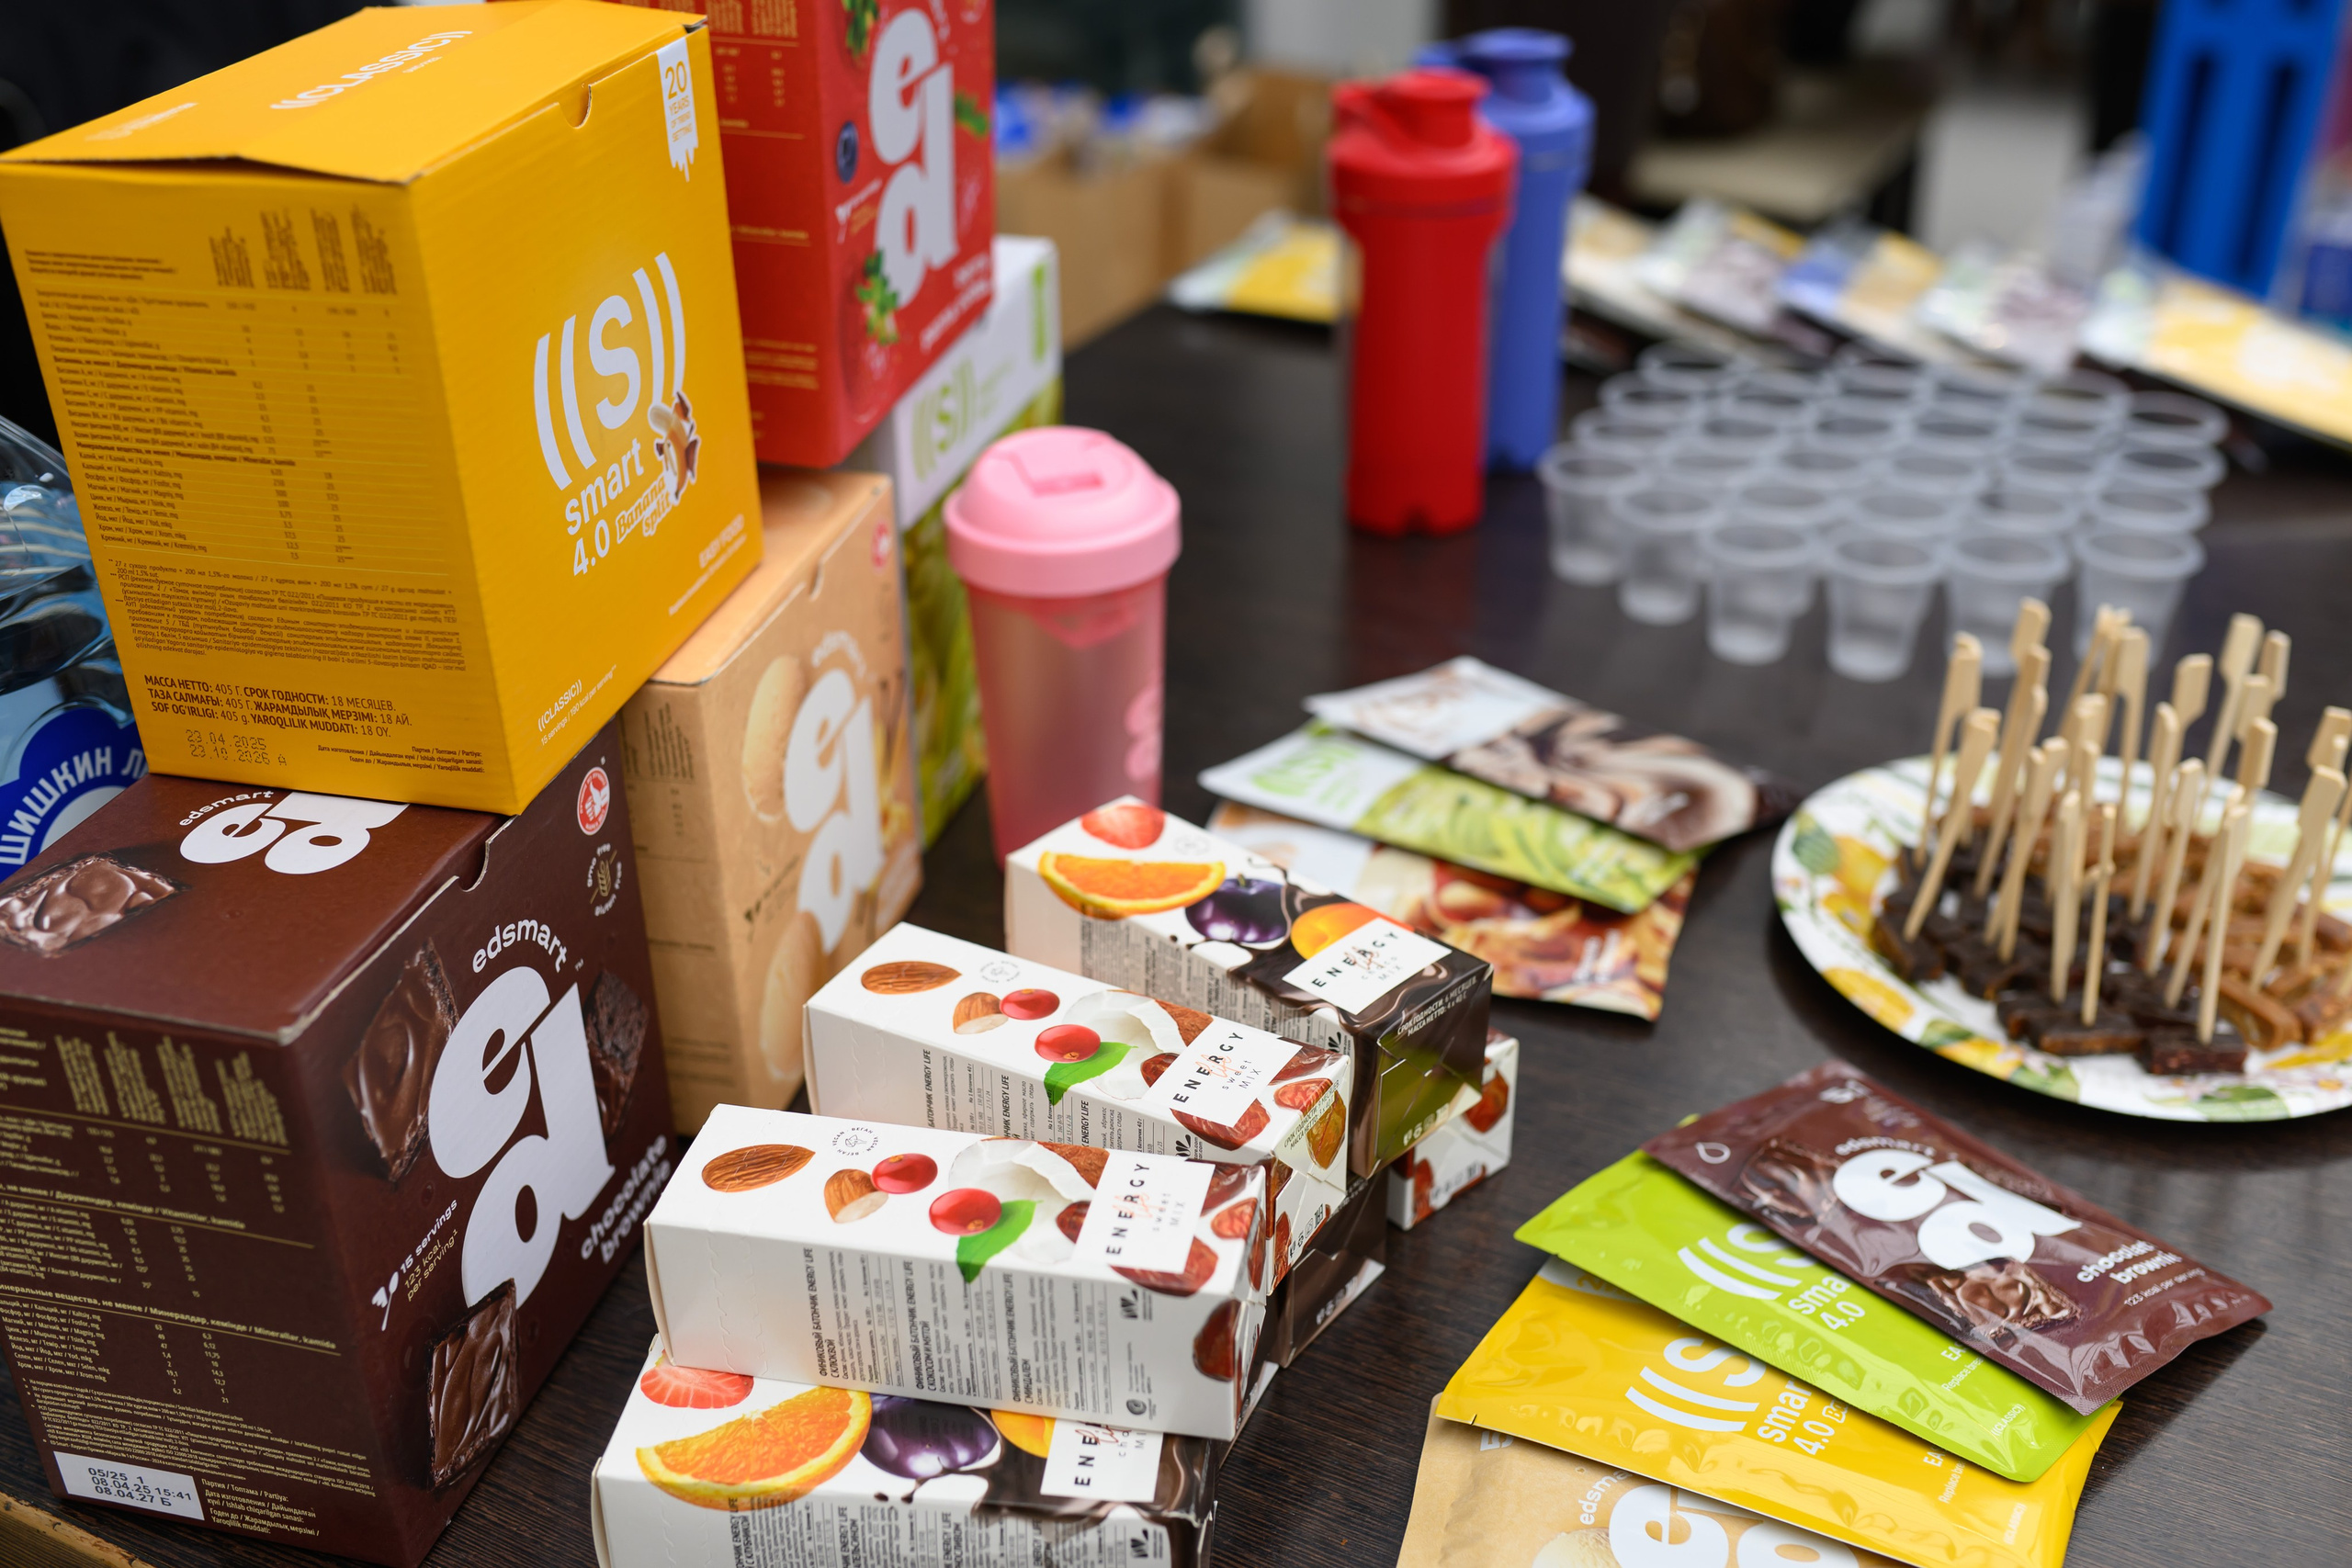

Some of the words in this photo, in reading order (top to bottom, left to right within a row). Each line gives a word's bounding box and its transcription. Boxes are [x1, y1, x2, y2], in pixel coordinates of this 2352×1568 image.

[665, 61, 687, 100] 20
[669, 96, 689, 116] YEARS
[565, 438, 644, 535] smart
[573, 519, 610, 576] 4.0
[616, 476, 667, 544] Banana
[643, 493, 671, 536] split
[144, 675, 176, 688] МАССА
[177, 679, 212, 693] НЕТТО:
[215, 683, 233, 695] 405
[235, 685, 243, 696] Г.
[243, 687, 270, 699] СРОК
[272, 690, 329, 705] ГОДНОСТИ:
[332, 695, 344, 707] 18
[346, 697, 396, 711] МЕСЯЦЕВ.
[148, 688, 173, 701] ТАЗА
[174, 692, 223, 707] САЛМАҒЫ:
[225, 698, 243, 709] 405
[245, 700, 253, 711] Г.
[254, 701, 331, 720] ЖАРАМДЫЛЫҚ
[332, 709, 378, 723] МЕРЗІМІ:
[380, 714, 393, 725] 18
[395, 714, 413, 727] АЙ.
[152, 701, 169, 713] SOF
[220, 710, 239, 722] 405
[241, 715, 250, 725] g.
[250, 714, 309, 729] YAROQLILIK
[310, 719, 358, 735] MUDDATI:
[360, 725, 373, 736] 18
[376, 726, 391, 738] OY.
[541, 735, 548, 745] 15
[548, 717, 567, 739] servings
[580, 693, 589, 707] kcal
[186, 729, 266, 750] 23.04.2025
[0, 746, 111, 865] ШИШКИН
[179, 790, 274, 827] edsmart
[472, 919, 567, 974] edsmart
[1311, 931, 1399, 987] ENERGY
[1397, 1021, 1413, 1035] СРОК
[1408, 1021, 1426, 1037] МАССА
[924, 1065, 933, 1091] ENERGY
[1001, 1075, 1010, 1090] LIFE
[1172, 1032, 1243, 1103] ENERGY
[1222, 1059, 1252, 1089] sweet
[1239, 1068, 1261, 1089] MIX
[925, 1093, 935, 1128] БАТОНЧИК
[1001, 1090, 1011, 1118] ENERGY
[1080, 1100, 1089, 1115] LIFE
[581, 1134, 667, 1260] chocolate
[601, 1159, 671, 1264] brownie
[1106, 1164, 1149, 1254] ENERGY
[401, 1254, 413, 1274] 15
[415, 1199, 458, 1257] servings
[404, 1265, 422, 1289] 123
[423, 1239, 441, 1267] kcal
[804, 1247, 814, 1263] LIFE
[2076, 1240, 2156, 1282] chocolat
[407, 1278, 422, 1303] per
[806, 1265, 817, 1292] ENERGY
[2124, 1293, 2143, 1306] 123
[2141, 1284, 2162, 1298] kcal
[2161, 1279, 2174, 1291] per
[0, 1283, 53, 1297] инеральные
[55, 1291, 100, 1305] вещества,
[102, 1300, 113, 1308] не
[116, 1302, 143, 1314] менее
[809, 1293, 821, 1330] БАТОНЧИК
[1788, 1276, 1851, 1315] sma
[1820, 1301, 1865, 1330] 4.0
[812, 1332, 827, 1376] ФИНИКОВЫЙ
[1941, 1364, 1970, 1392] Replace
[1757, 1380, 1813, 1443] smar
[1117, 1430, 1129, 1457] cho
[1793, 1420, 1835, 1455] 4.0
[1074, 1423, 1102, 1486] ENE
[1923, 1449, 1946, 1468] EA
[88, 1467, 128, 1482] 05/25
[137, 1475, 145, 1485] 1
[92, 1476, 152, 1495] 08.04.25
[155, 1486, 192, 1502] 15:41
[201, 1478, 227, 1490] Партия
[232, 1483, 258, 1496] Топтама
[264, 1490, 288, 1503] Partiya:
[95, 1485, 154, 1505] 08.04.27
[205, 1489, 220, 1499] Дата
[221, 1493, 266, 1508] изготовления
[226, 1500, 245, 1512] Ishlab
[246, 1505, 281, 1519] chiqarilgan
[282, 1512, 304, 1523] sanasi:
[1578, 1470, 1634, 1525] edsma
[209, 1507, 229, 1518] Годен
[231, 1512, 239, 1521] до
[211, 1516, 241, 1529] Yaroqlilik
[242, 1522, 271, 1535] muddati:
